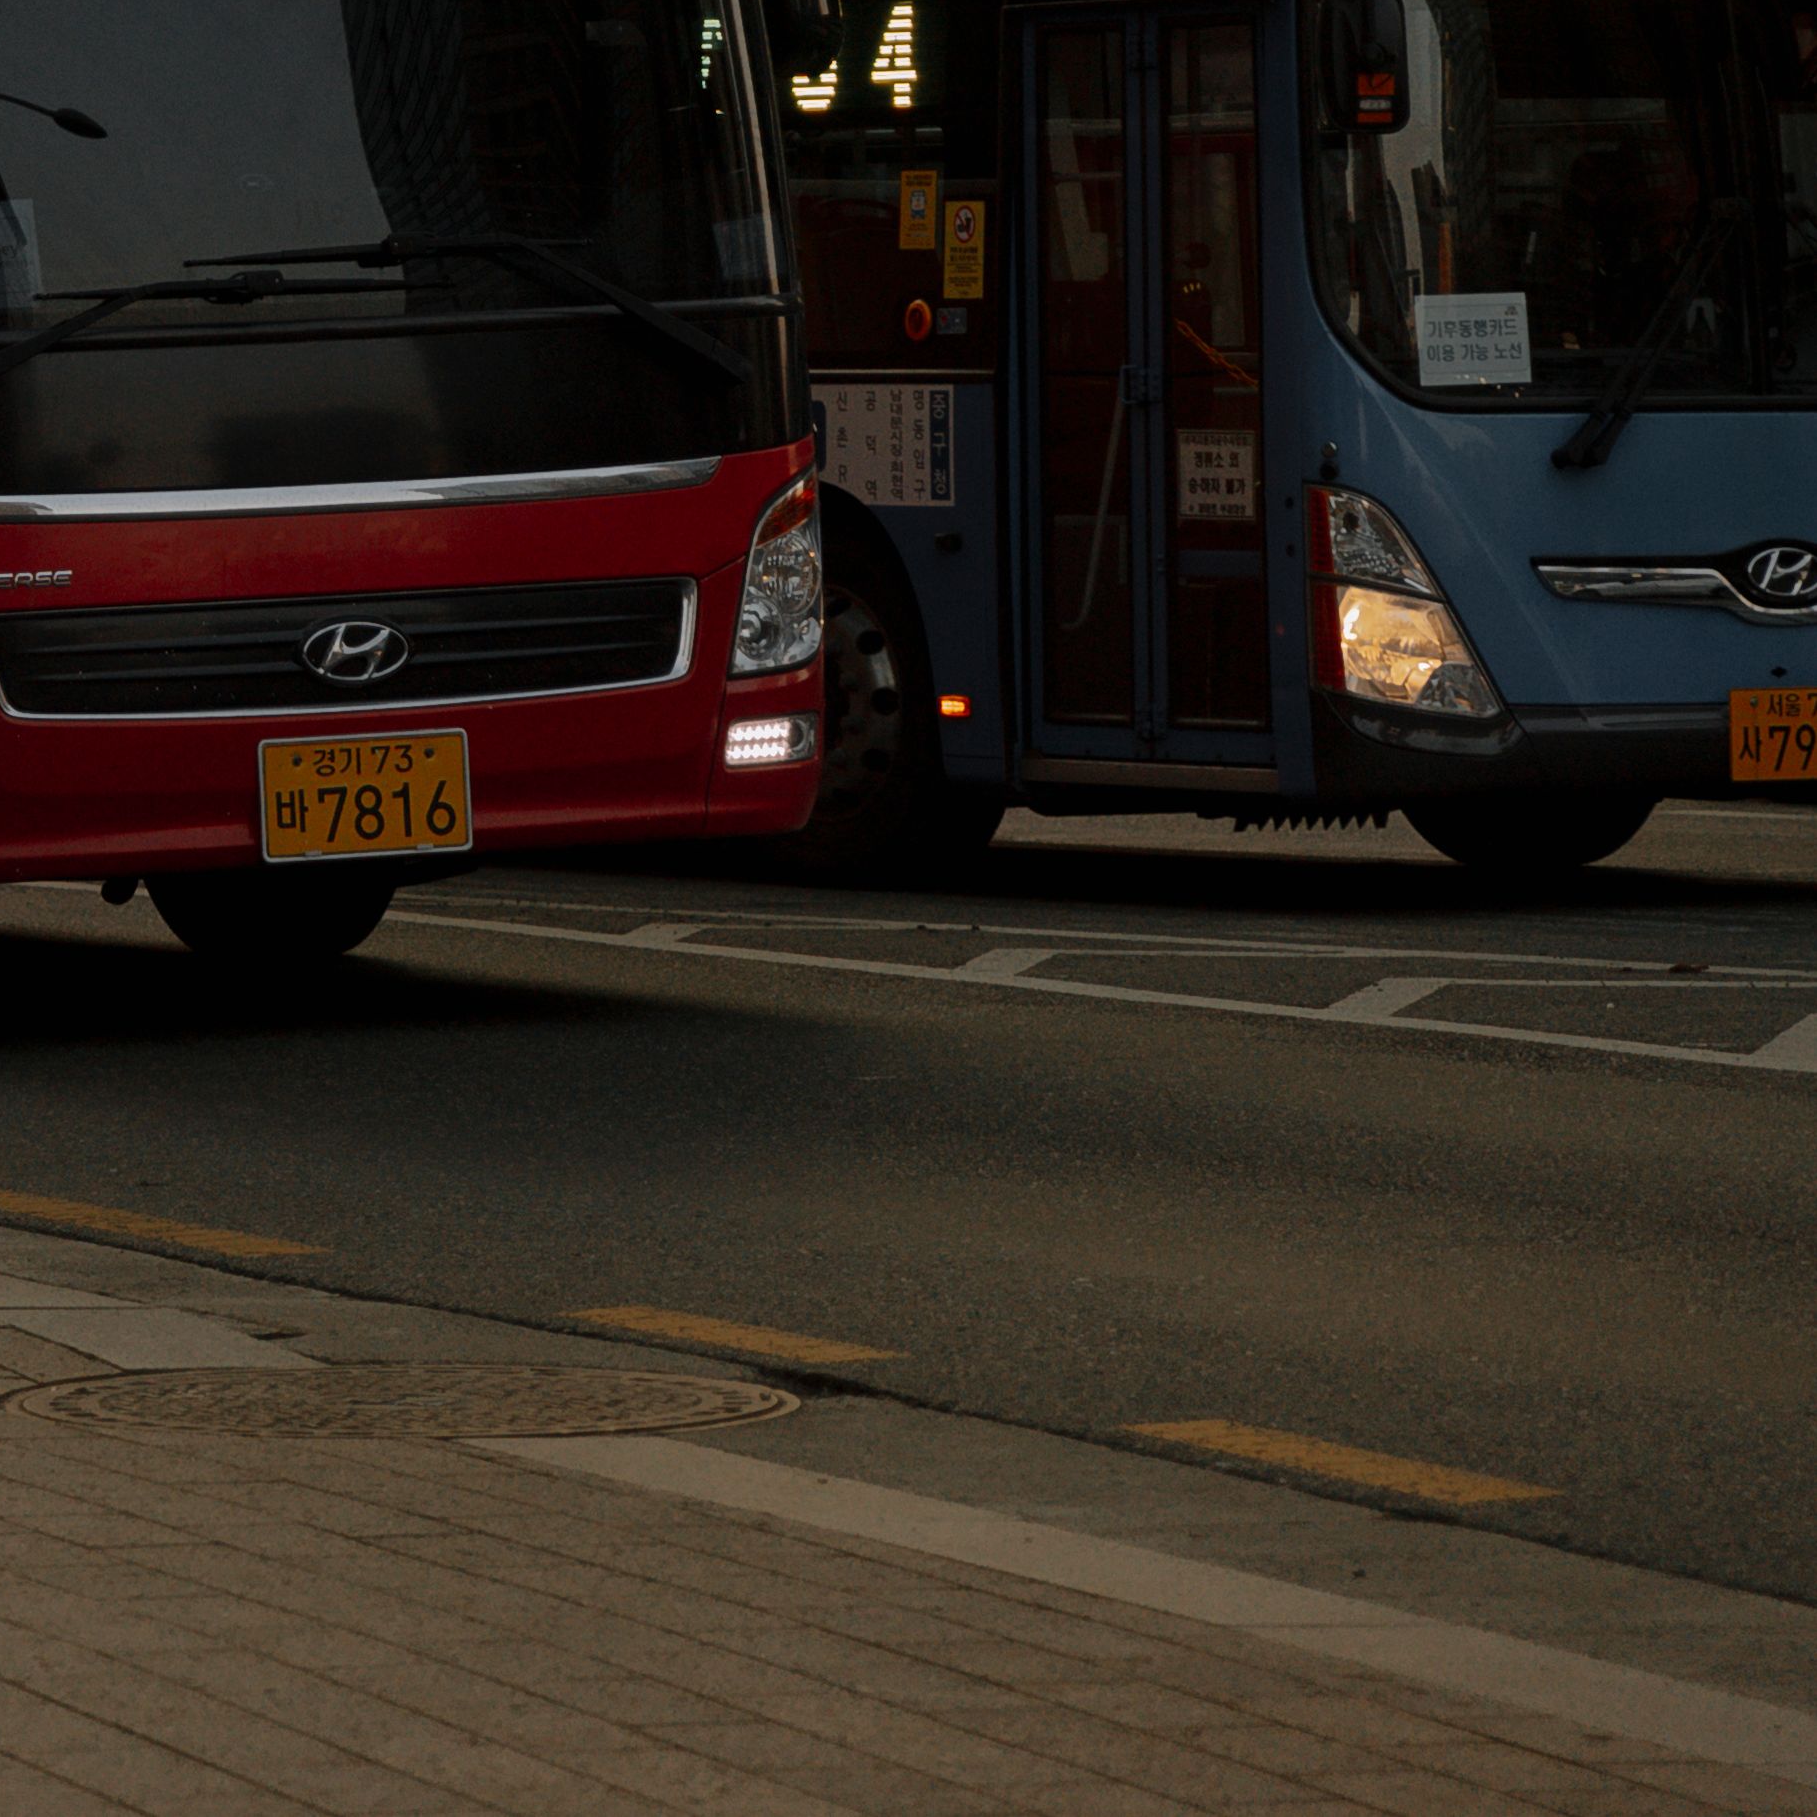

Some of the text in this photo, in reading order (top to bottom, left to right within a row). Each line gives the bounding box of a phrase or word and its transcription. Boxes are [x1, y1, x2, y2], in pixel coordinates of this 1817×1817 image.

[1426, 318, 1518, 339] 기후동행카드
[1426, 341, 1523, 363] 이용 가능 노선
